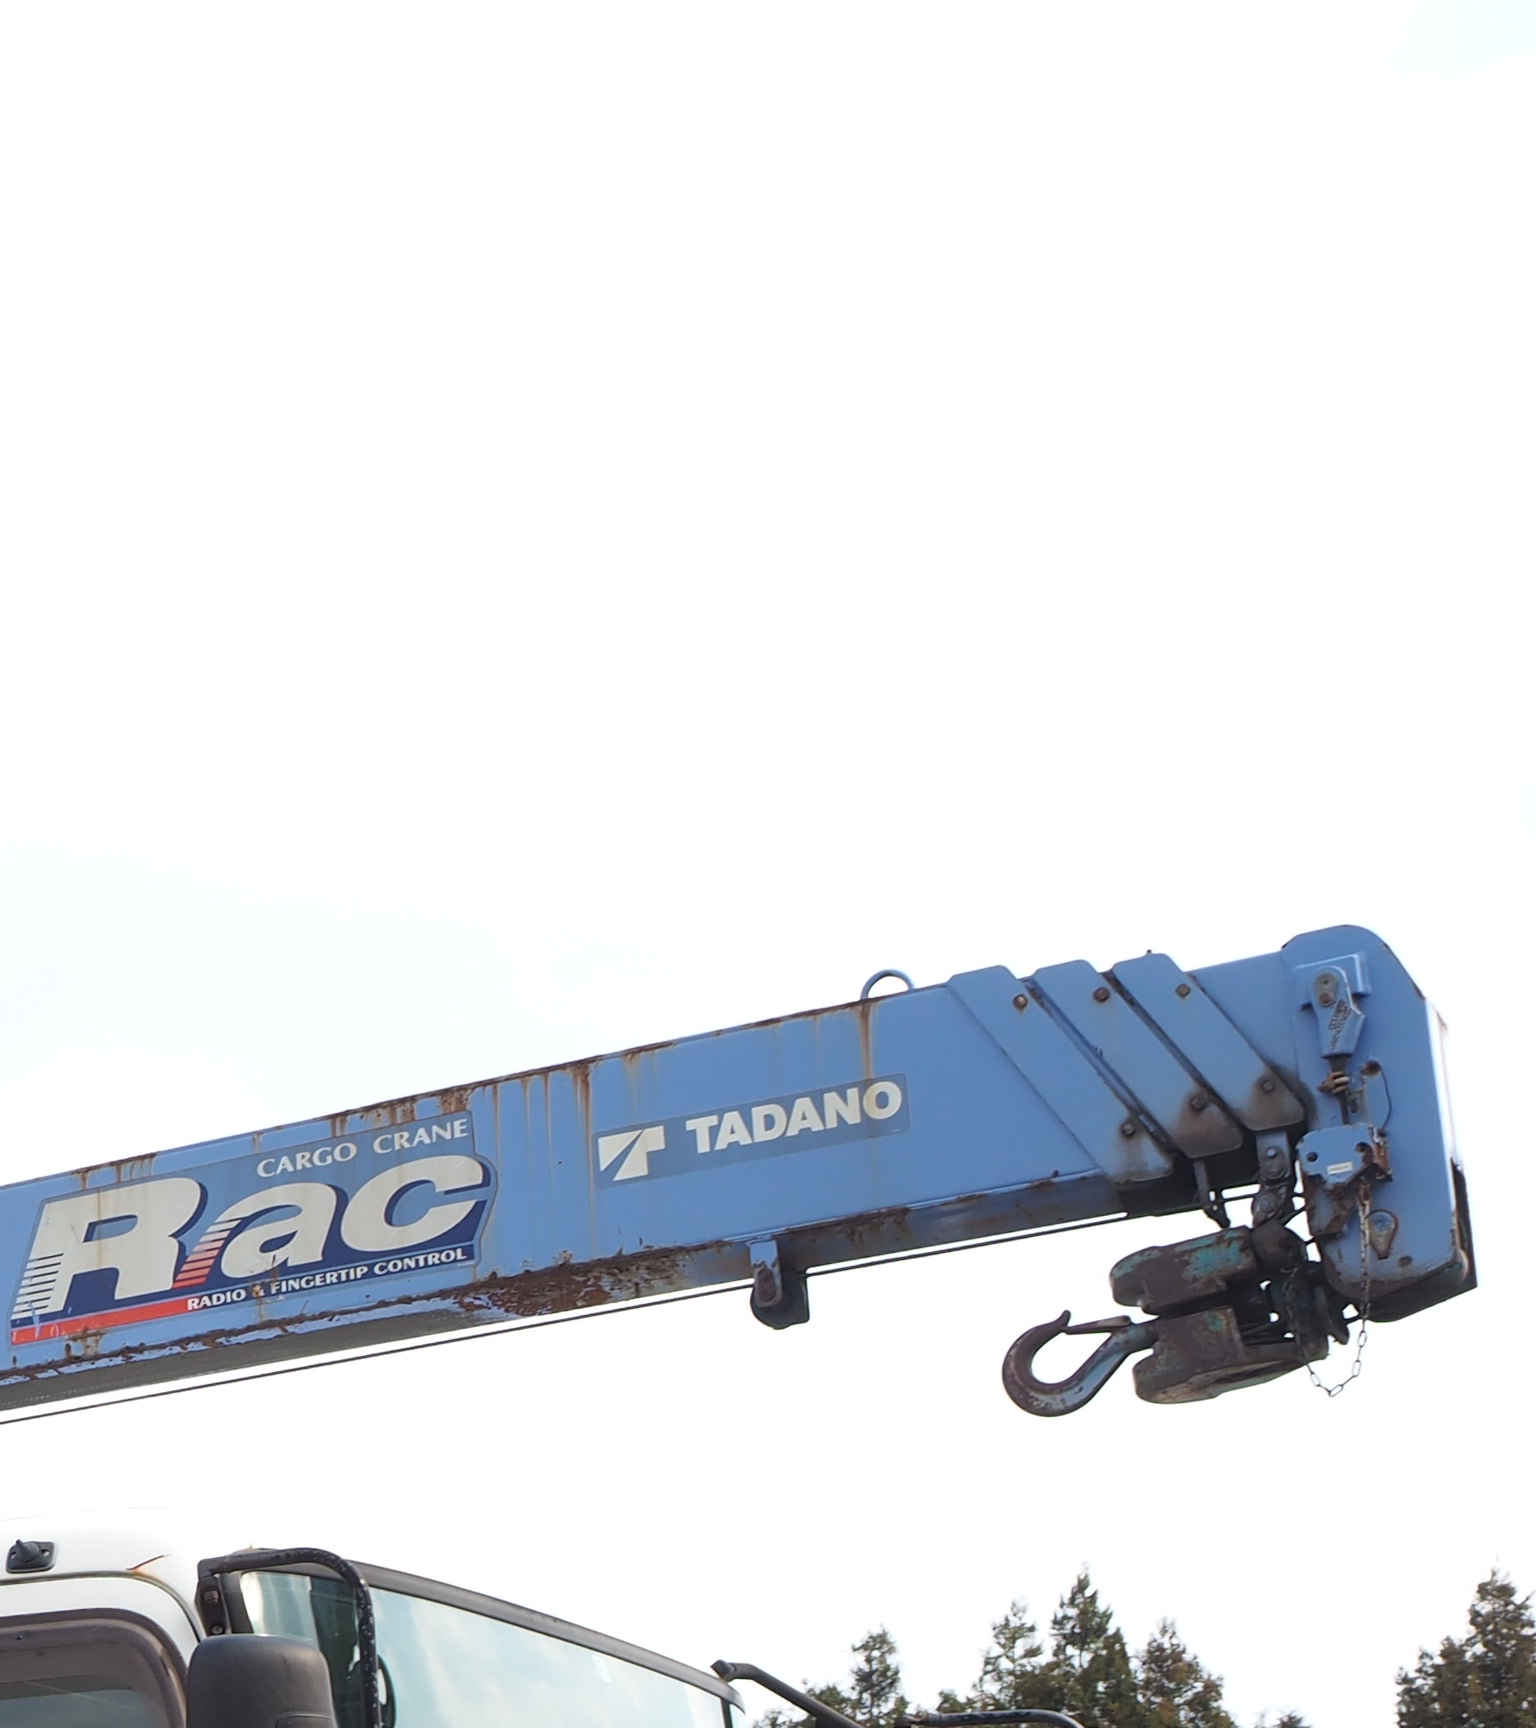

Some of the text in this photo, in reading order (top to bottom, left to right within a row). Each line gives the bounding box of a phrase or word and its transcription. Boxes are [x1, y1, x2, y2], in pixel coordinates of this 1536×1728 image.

[256, 1118, 469, 1178] CARGO CRANE
[685, 1081, 902, 1154] TADANO
[11, 1155, 485, 1321] Rac
[187, 1287, 247, 1311] RADIO
[270, 1264, 369, 1295] FINGERTIP
[373, 1247, 467, 1276] CONTROL
